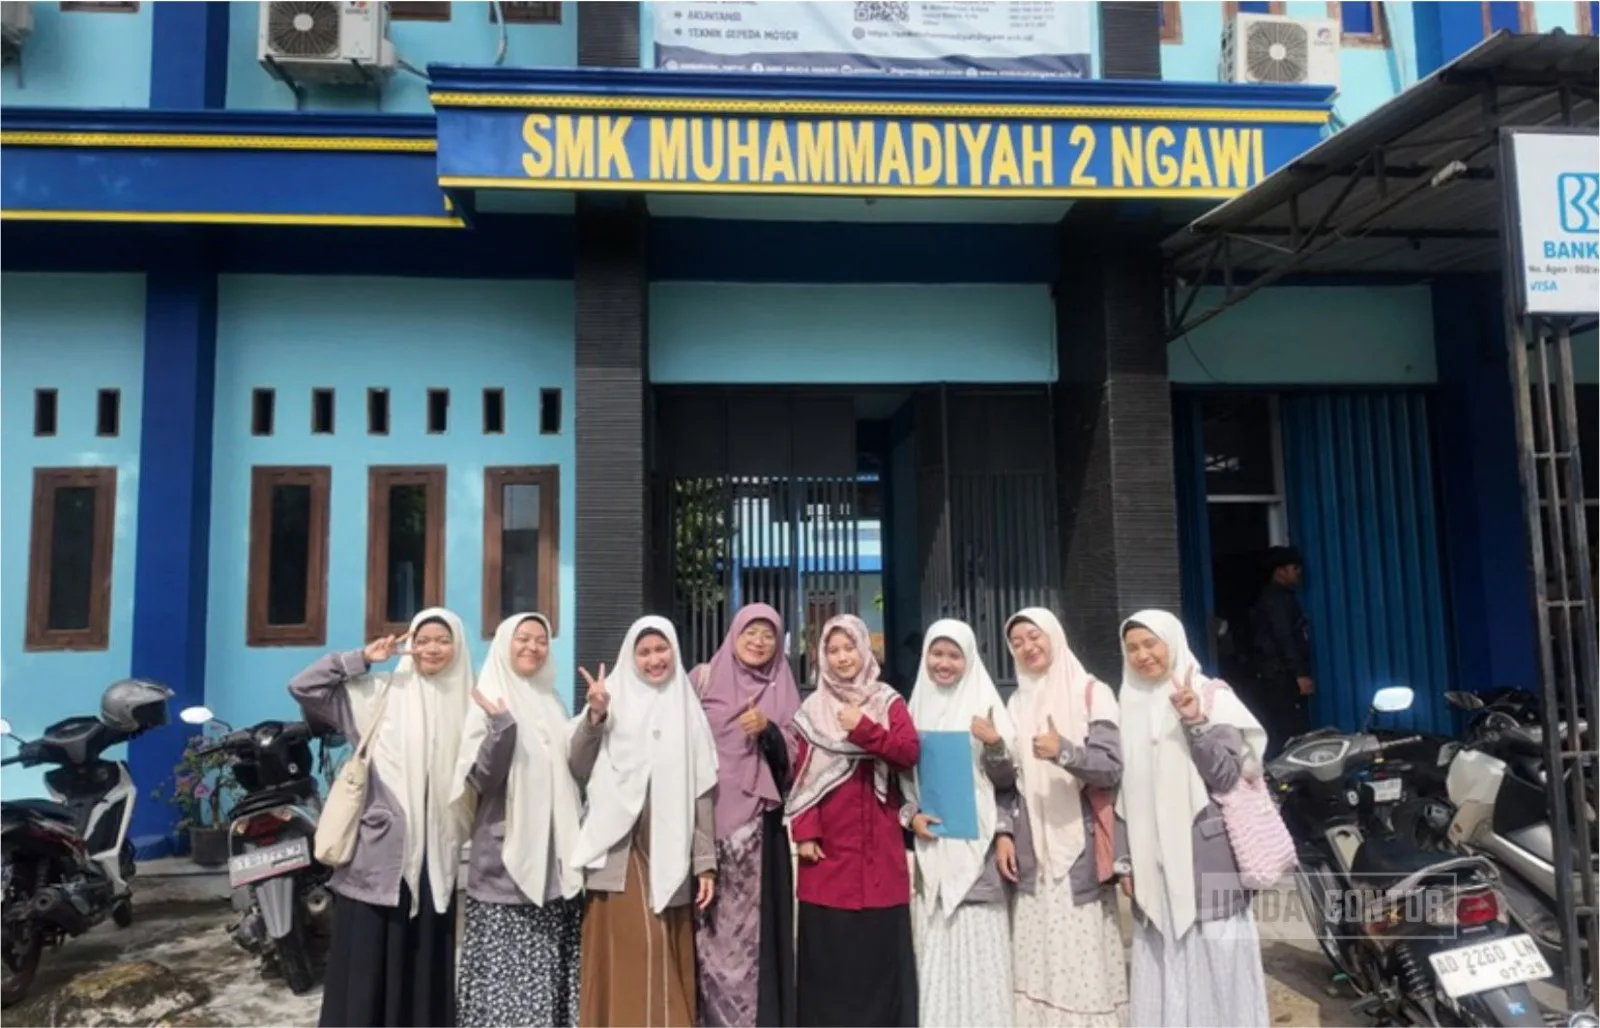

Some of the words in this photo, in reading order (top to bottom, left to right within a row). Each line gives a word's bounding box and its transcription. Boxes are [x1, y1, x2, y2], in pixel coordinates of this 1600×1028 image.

[521, 113, 634, 179] SMK
[651, 117, 1053, 186] MUHAMMADIYAH
[1069, 124, 1097, 187] 2
[1111, 126, 1265, 188] NGAWI
[1543, 240, 1600, 259] BANK
[1530, 280, 1558, 291] VISA
[1435, 954, 1460, 976] AD
[1461, 943, 1507, 969] 2260
